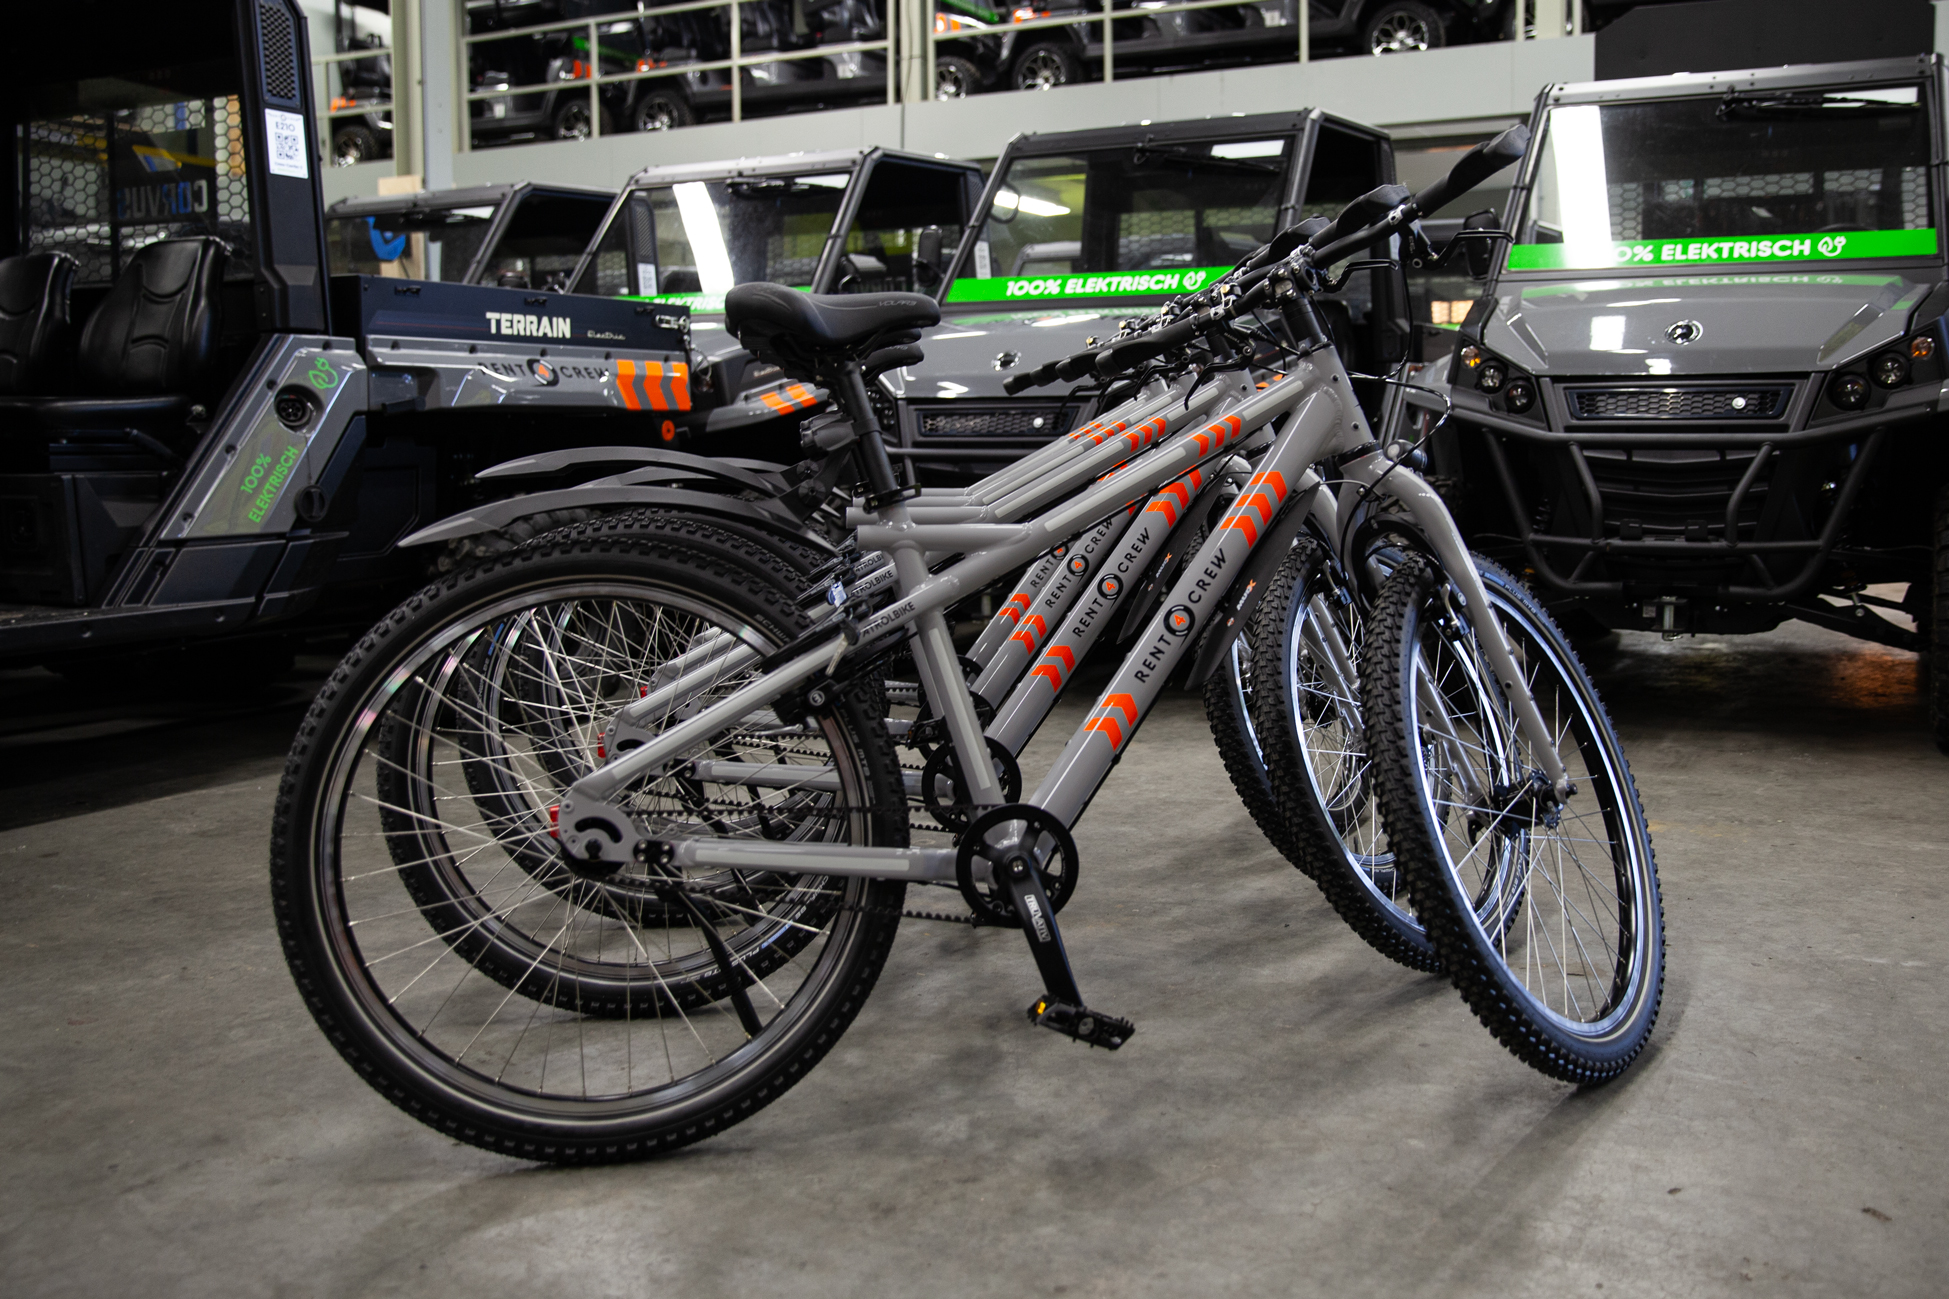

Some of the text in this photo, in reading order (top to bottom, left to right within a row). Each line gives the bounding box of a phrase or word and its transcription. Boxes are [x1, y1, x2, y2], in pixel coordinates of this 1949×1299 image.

[1661, 238, 1811, 261] ELEKTRISCH
[1006, 273, 1180, 296] 100% ELEKTRISCH
[485, 312, 571, 339] TERRAIN
[240, 453, 272, 494] 100%
[248, 445, 299, 523] ELEKTRISCH
[1030, 559, 1054, 588] RENT
[1044, 574, 1072, 608] RENT
[1084, 519, 1113, 554] CREW
[1072, 597, 1104, 637] RENT
[1117, 526, 1151, 573] CREW
[862, 601, 916, 637] ATROLBIKE
[1134, 634, 1171, 683] RENT
[1187, 547, 1228, 604] CREW
